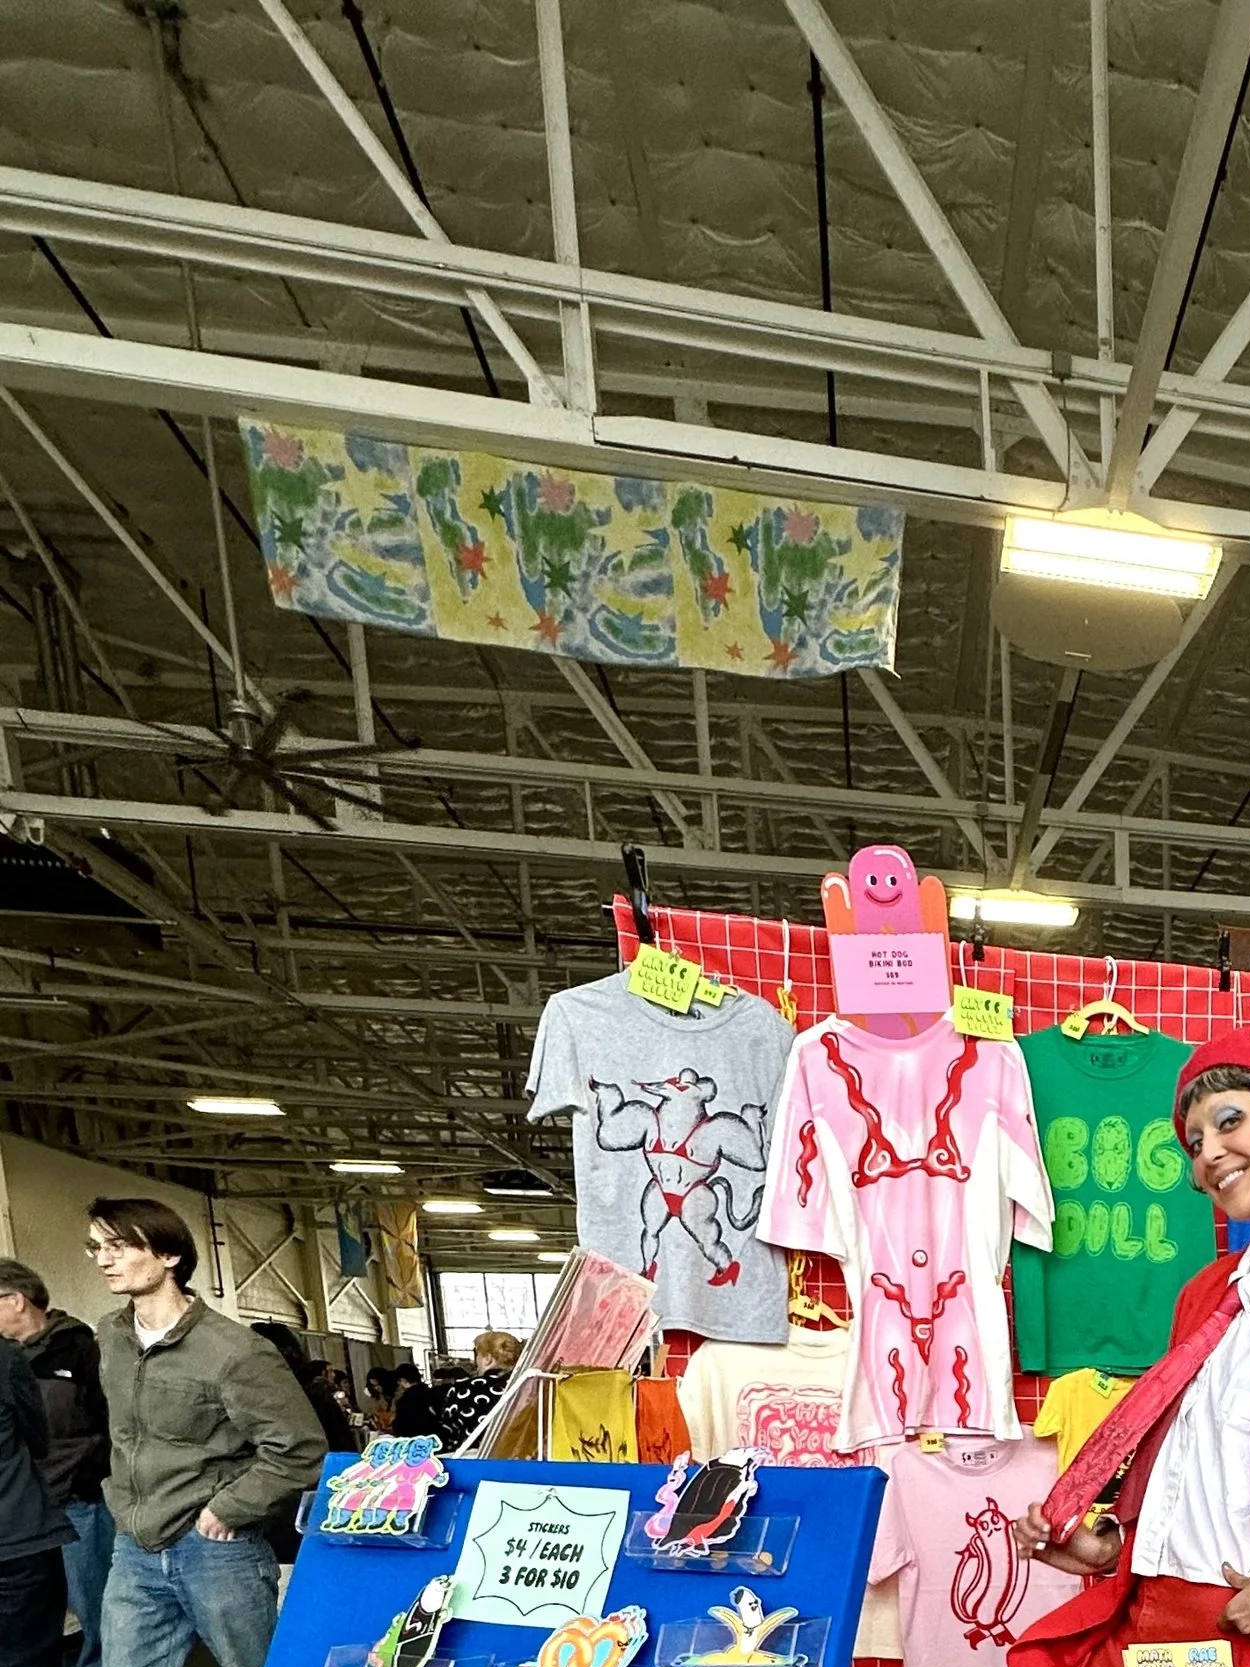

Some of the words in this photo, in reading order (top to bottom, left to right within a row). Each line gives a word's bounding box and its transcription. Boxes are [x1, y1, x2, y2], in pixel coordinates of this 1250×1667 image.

[1053, 1199, 1179, 1263] DILL
[528, 1522, 570, 1535] STICKERS
[499, 1565, 512, 1584] 3
[514, 1566, 548, 1588] FOR
[550, 1567, 580, 1590] $10
